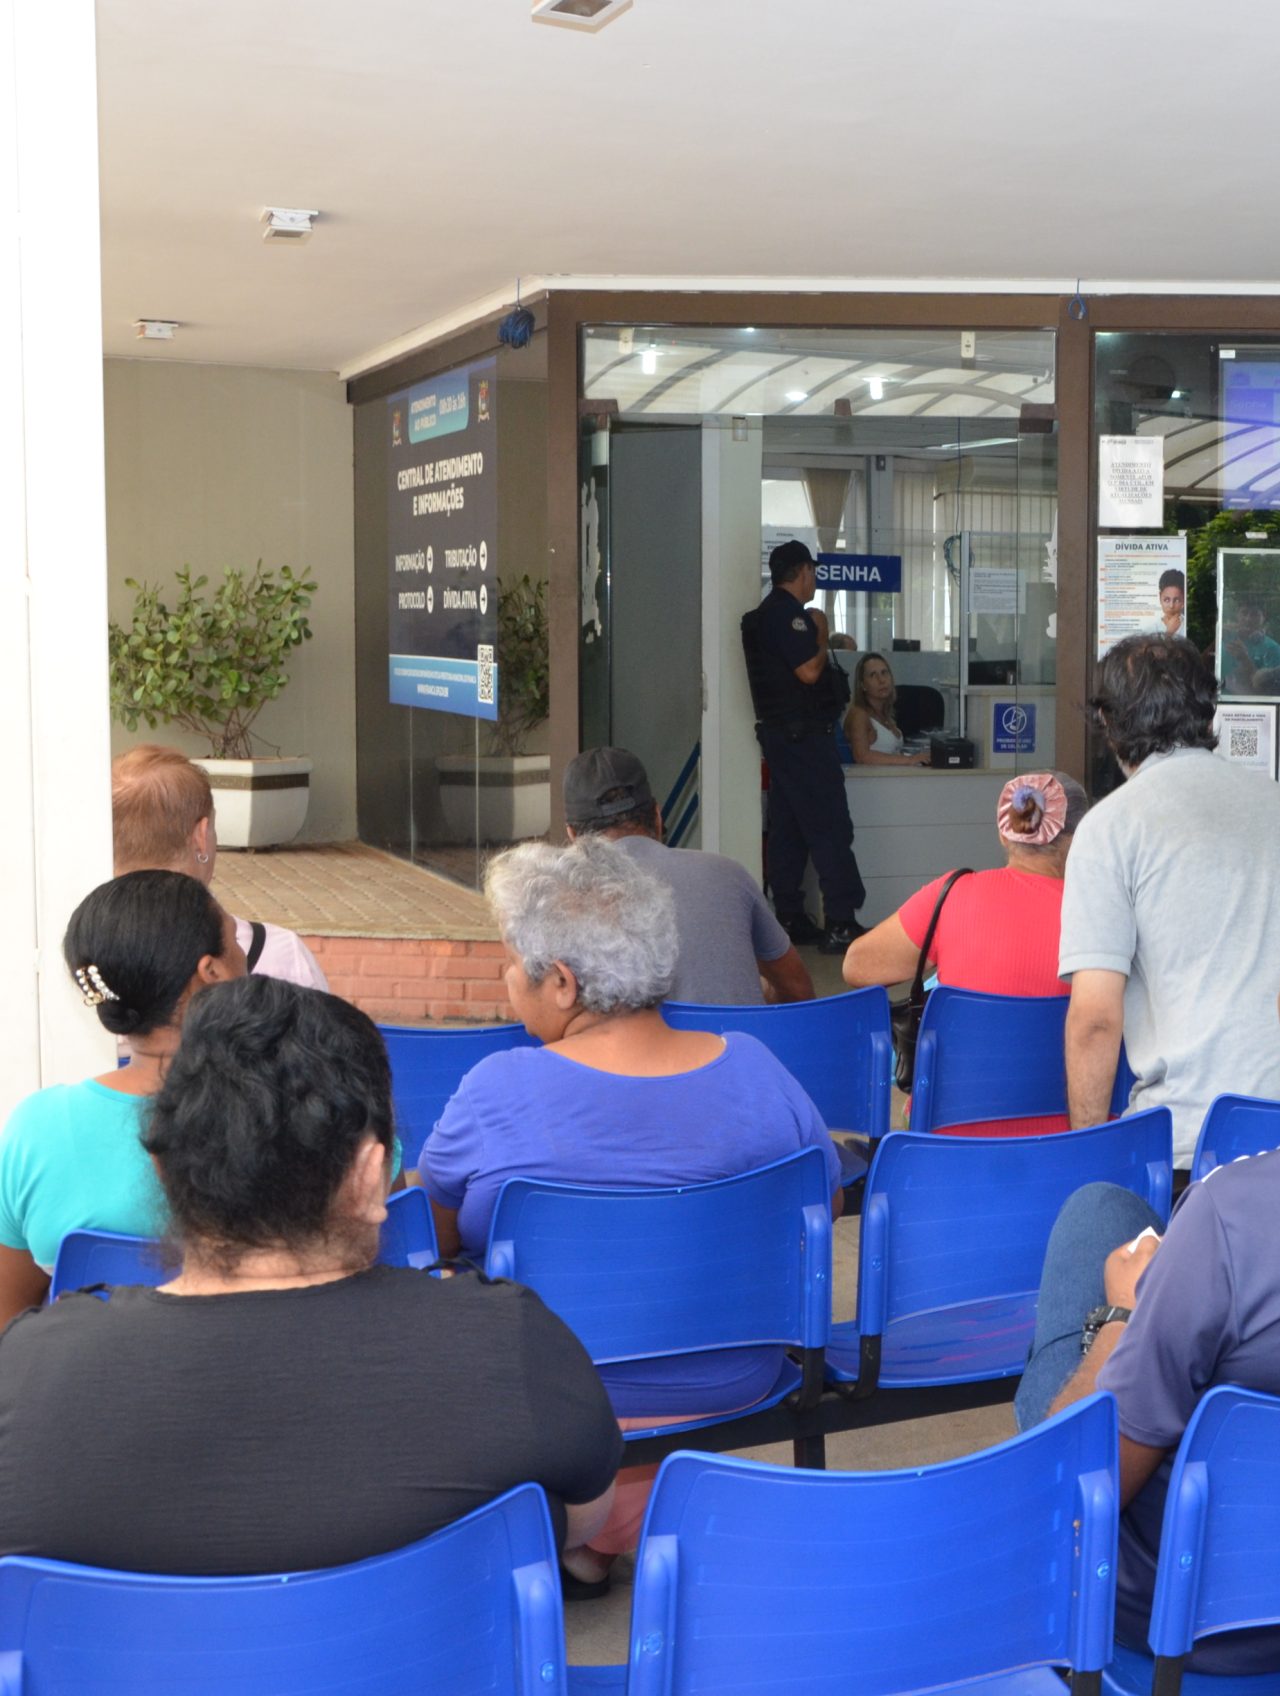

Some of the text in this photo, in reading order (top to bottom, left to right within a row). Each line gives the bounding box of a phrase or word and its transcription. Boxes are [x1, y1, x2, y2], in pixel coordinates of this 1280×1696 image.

[397, 451, 483, 491] CENTRAL DE ATENDIMENTO
[413, 483, 464, 517] E INFORMAÇÕES
[445, 545, 477, 570] TRIBUTAÇÃO
[1115, 541, 1168, 551] DÍVIDA ATIVA
[395, 549, 425, 574] INFORMAÇÃO
[816, 564, 882, 583] SENHA
[398, 591, 425, 610] PROTOCOLO
